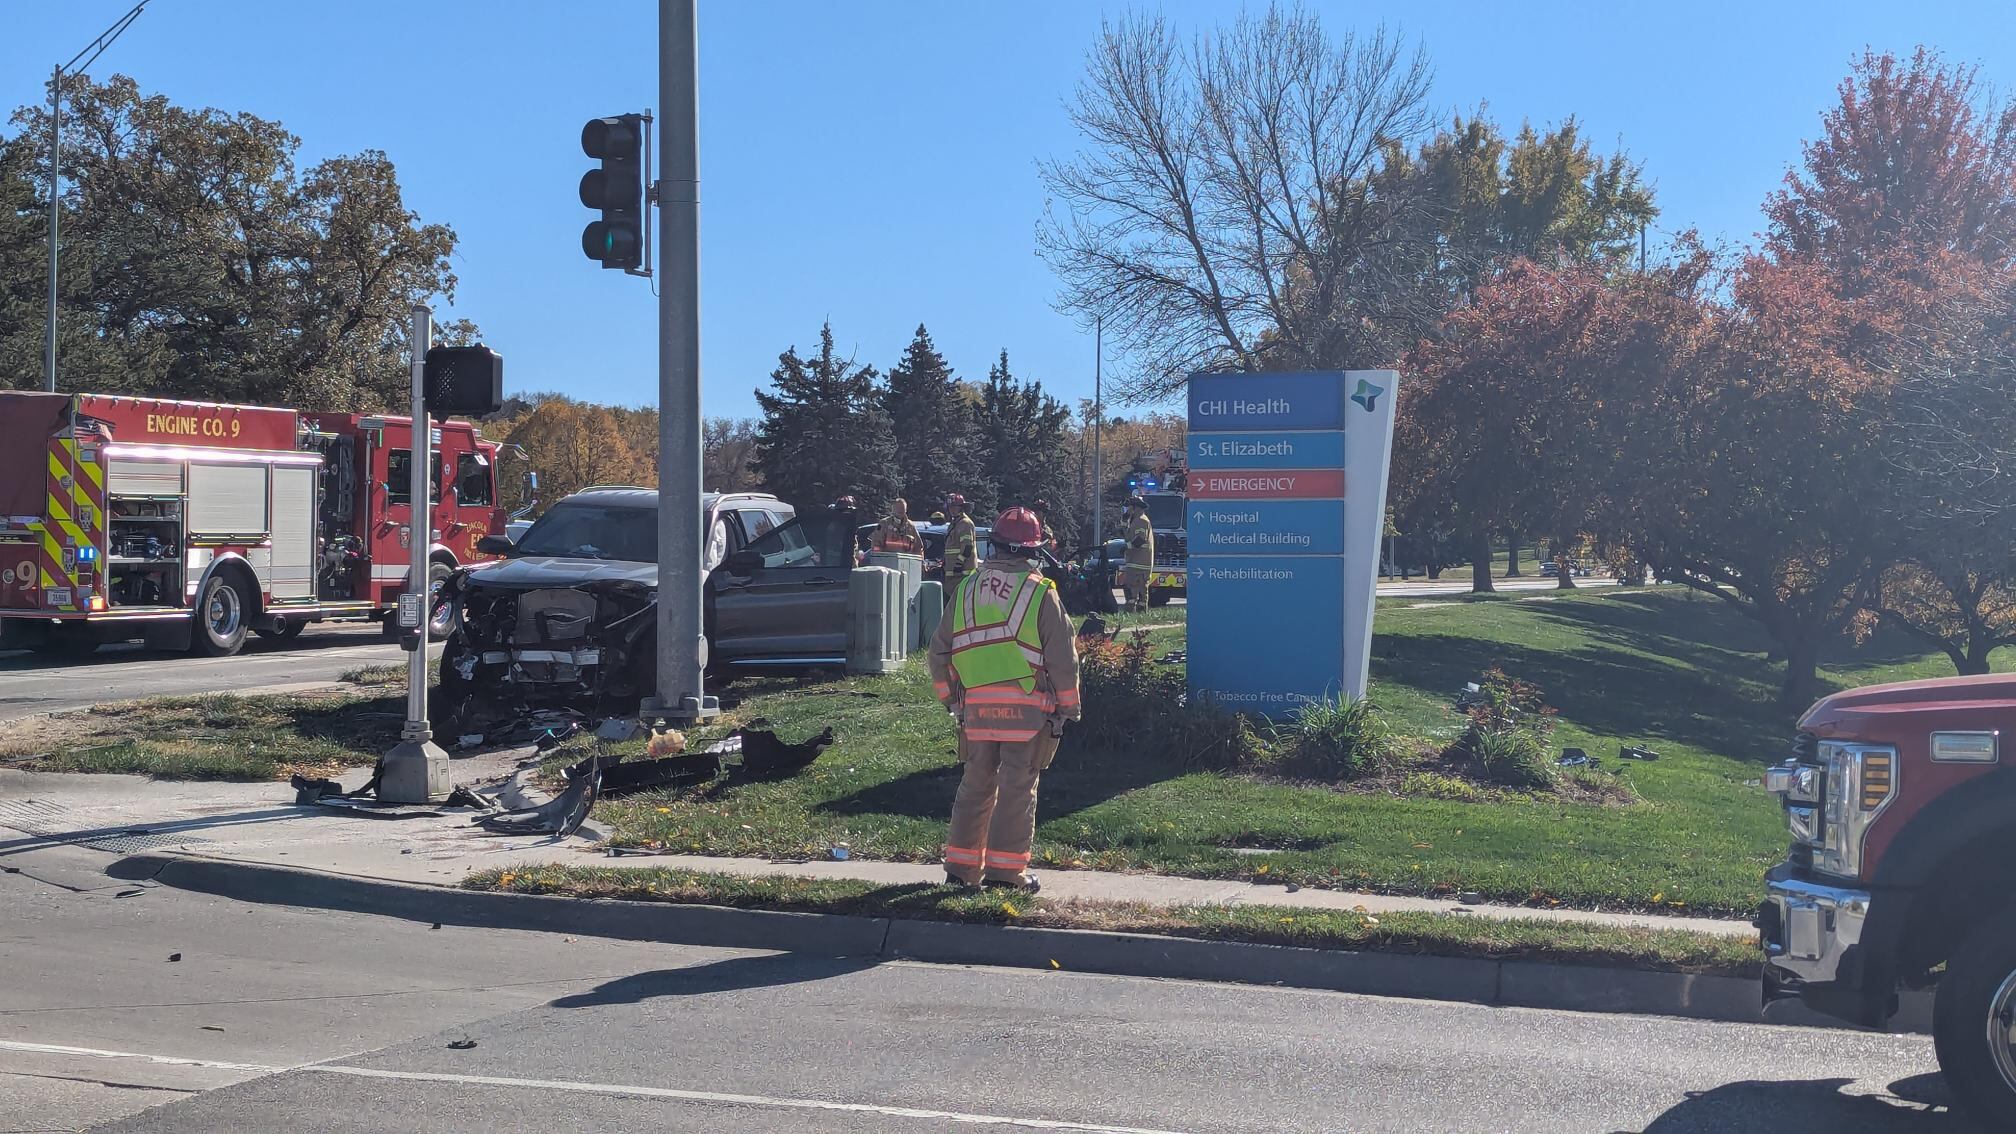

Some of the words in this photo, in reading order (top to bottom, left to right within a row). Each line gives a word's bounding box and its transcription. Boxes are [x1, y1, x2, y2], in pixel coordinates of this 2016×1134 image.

[1198, 400, 1227, 416] CHI
[1233, 398, 1290, 415] Health
[147, 414, 198, 435] ENGINE
[202, 418, 226, 437] CO.
[231, 419, 240, 438] 9
[1198, 442, 1217, 457] St.
[1221, 440, 1293, 456] Elizabeth
[1209, 477, 1296, 491] EMERGENCY
[1209, 511, 1259, 526] Hospital
[1209, 532, 1257, 545] Medical
[1260, 532, 1311, 547] Building
[16, 560, 37, 591] 9
[1209, 567, 1293, 580] Rehabilitation
[1215, 690, 1258, 702] Tobacco
[1260, 691, 1283, 703] Free
[1286, 692, 1326, 704] Campu
